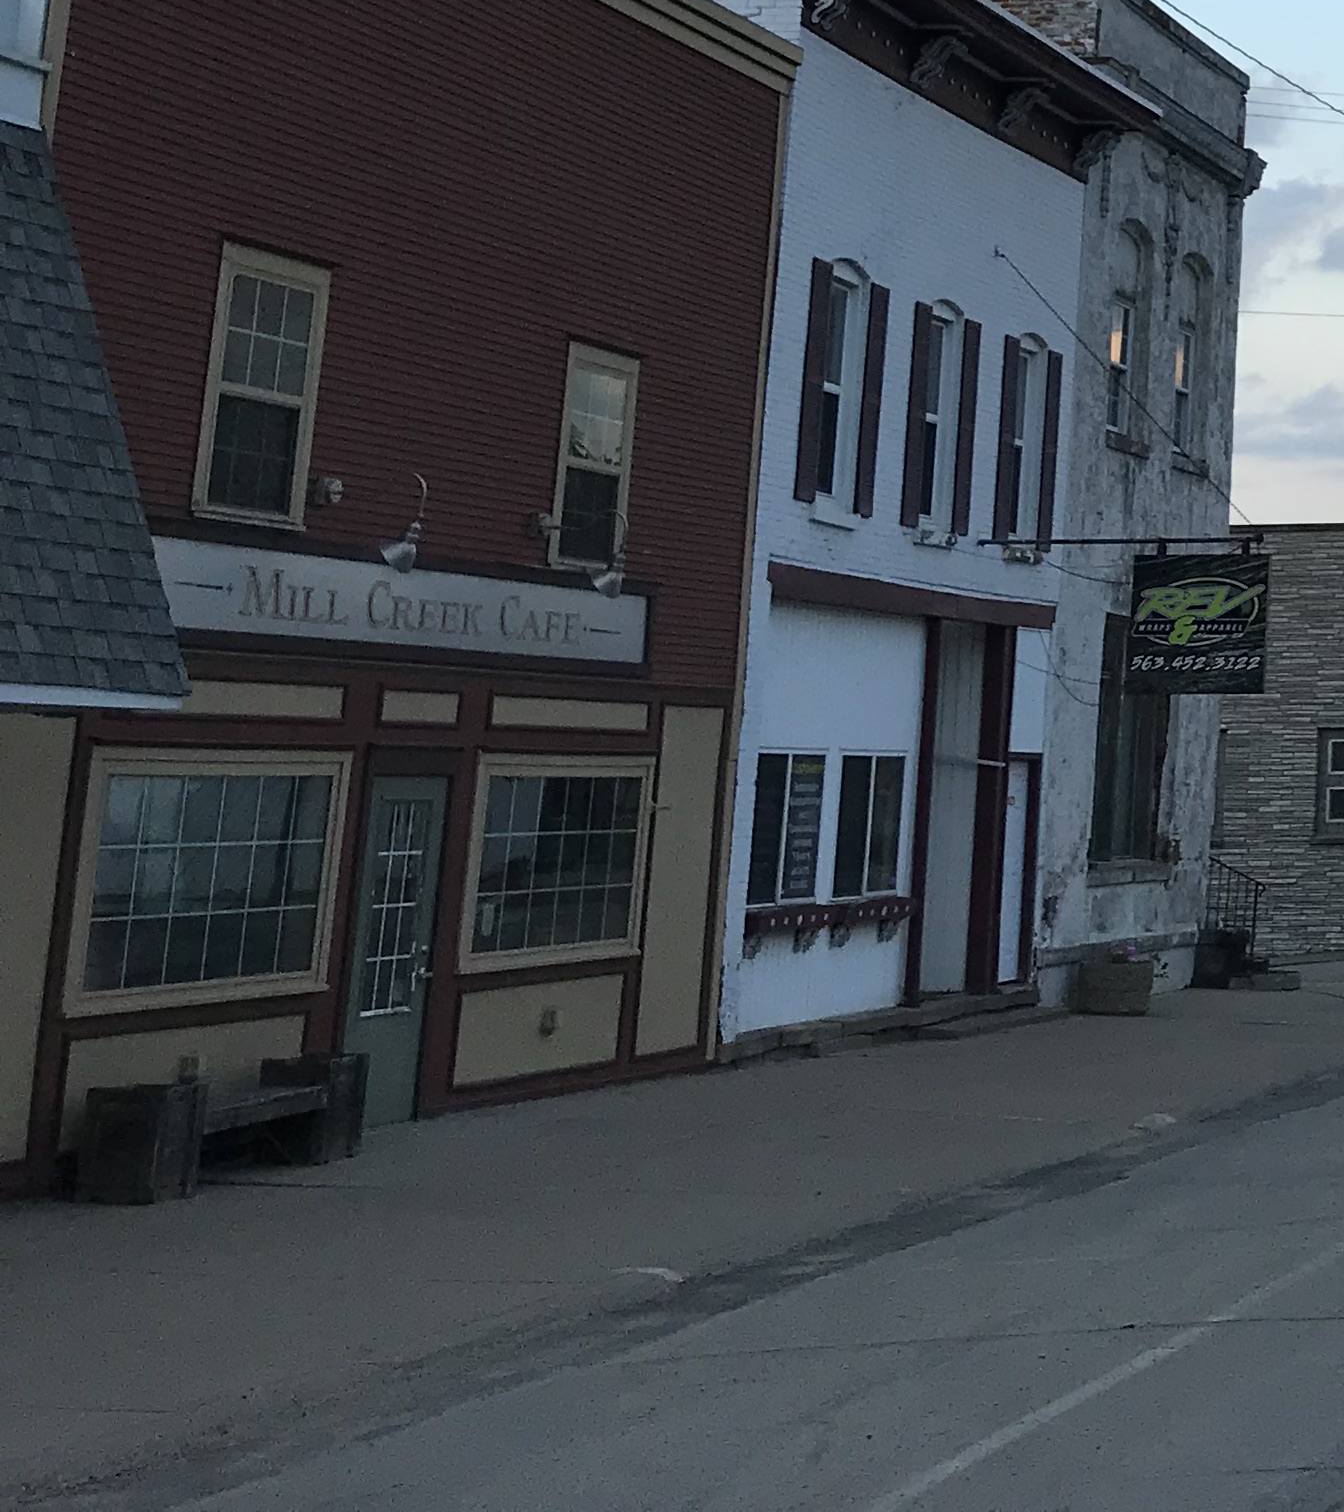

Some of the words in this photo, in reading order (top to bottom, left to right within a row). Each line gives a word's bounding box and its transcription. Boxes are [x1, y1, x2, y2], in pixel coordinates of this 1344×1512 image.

[239, 564, 349, 626] MILL
[366, 579, 484, 637] CREEK
[499, 595, 581, 645] CAFE
[1134, 583, 1266, 622] REV
[1138, 624, 1172, 632] WRAPS
[1168, 616, 1198, 645] &
[1198, 624, 1244, 632] APPAREL
[1130, 655, 1262, 671] 563.452.3122
